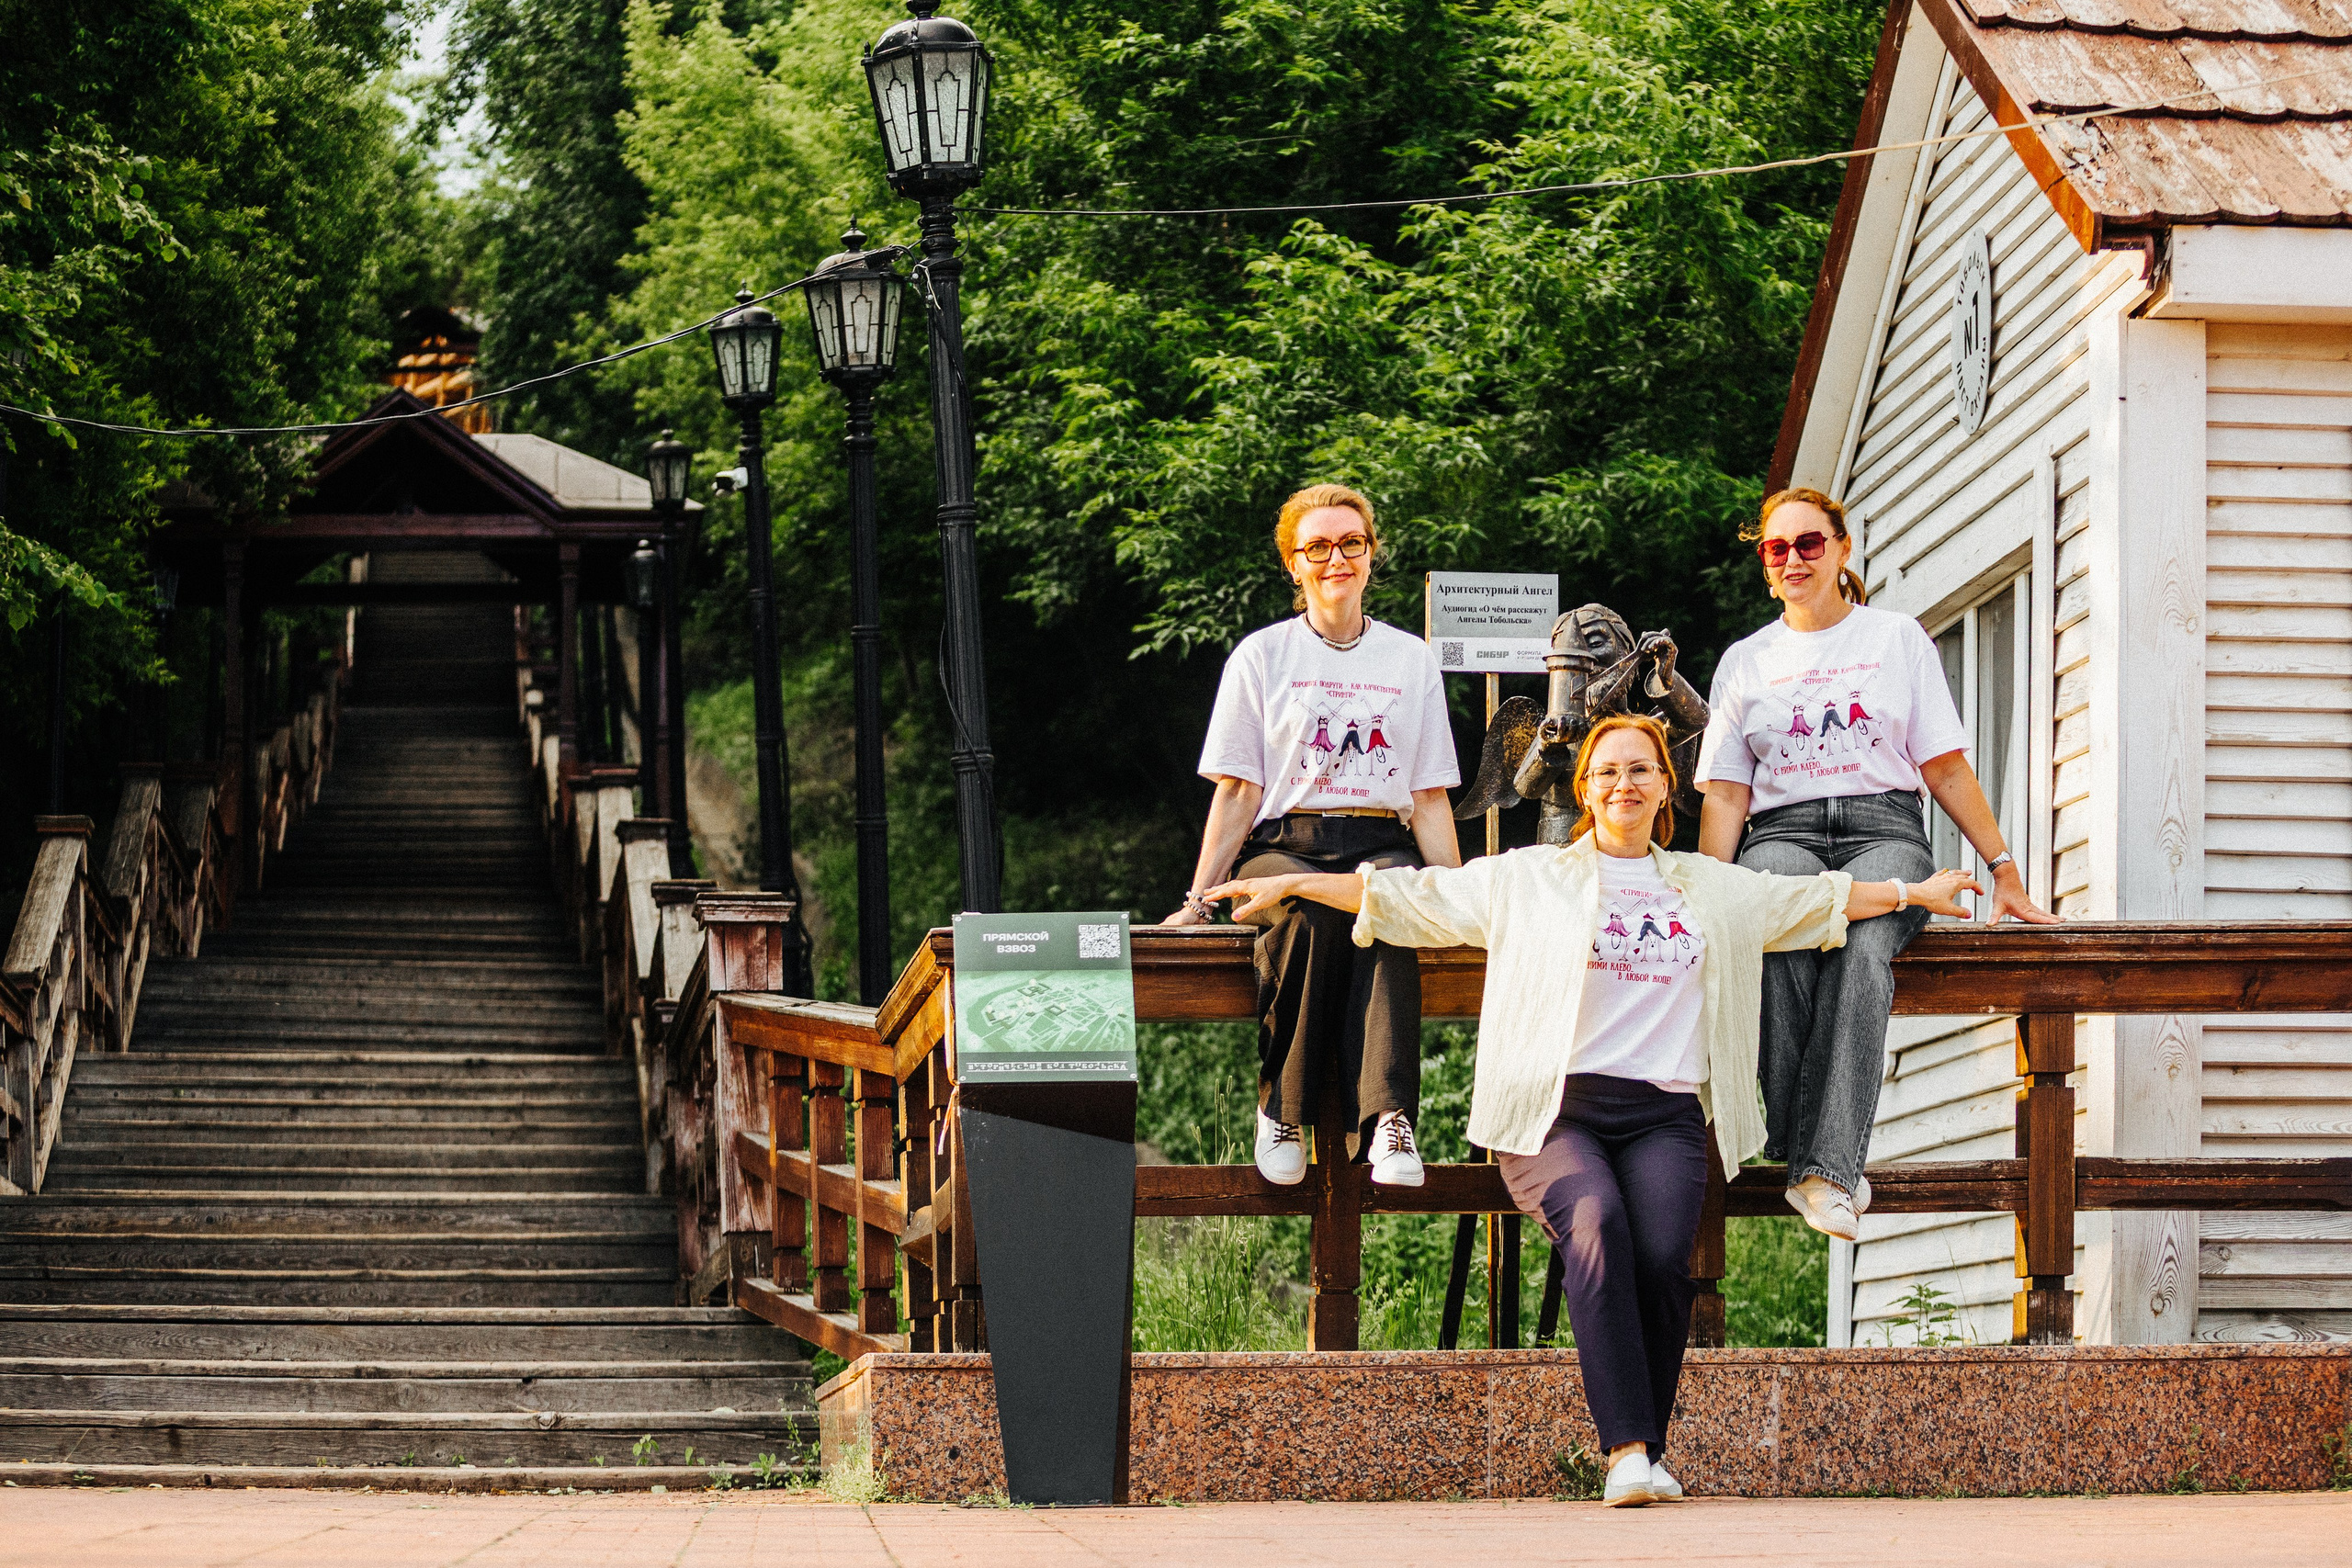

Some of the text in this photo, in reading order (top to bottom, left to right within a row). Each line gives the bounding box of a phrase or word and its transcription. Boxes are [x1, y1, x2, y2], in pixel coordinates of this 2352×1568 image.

[1957, 251, 1985, 306] ТОБОЛЬСК
[1957, 337, 1985, 416] ПОСТ ОХРАНЫ
[1436, 584, 1553, 597] Архитектурный Ангел
[1442, 604, 1477, 614] Аудиогид
[1478, 604, 1490, 613] «О
[1508, 607, 1547, 615] расскажут
[1774, 768, 1780, 776] С
[1816, 765, 1839, 777] ЛЮБОЙ
[1842, 762, 1861, 773] ЖОПЕ!
[1326, 785, 1349, 795] ЛЮБОЙ
[1351, 788, 1370, 797] ЖОПЕ!
[983, 931, 1049, 942] ПРЯМСКОЙ
[997, 944, 1036, 953] ВЗВОЗ
[1588, 961, 1608, 970] НИМИ
[1625, 972, 1649, 982] ЛЮБОЙ
[1652, 975, 1672, 985] ЖОПЕ!
